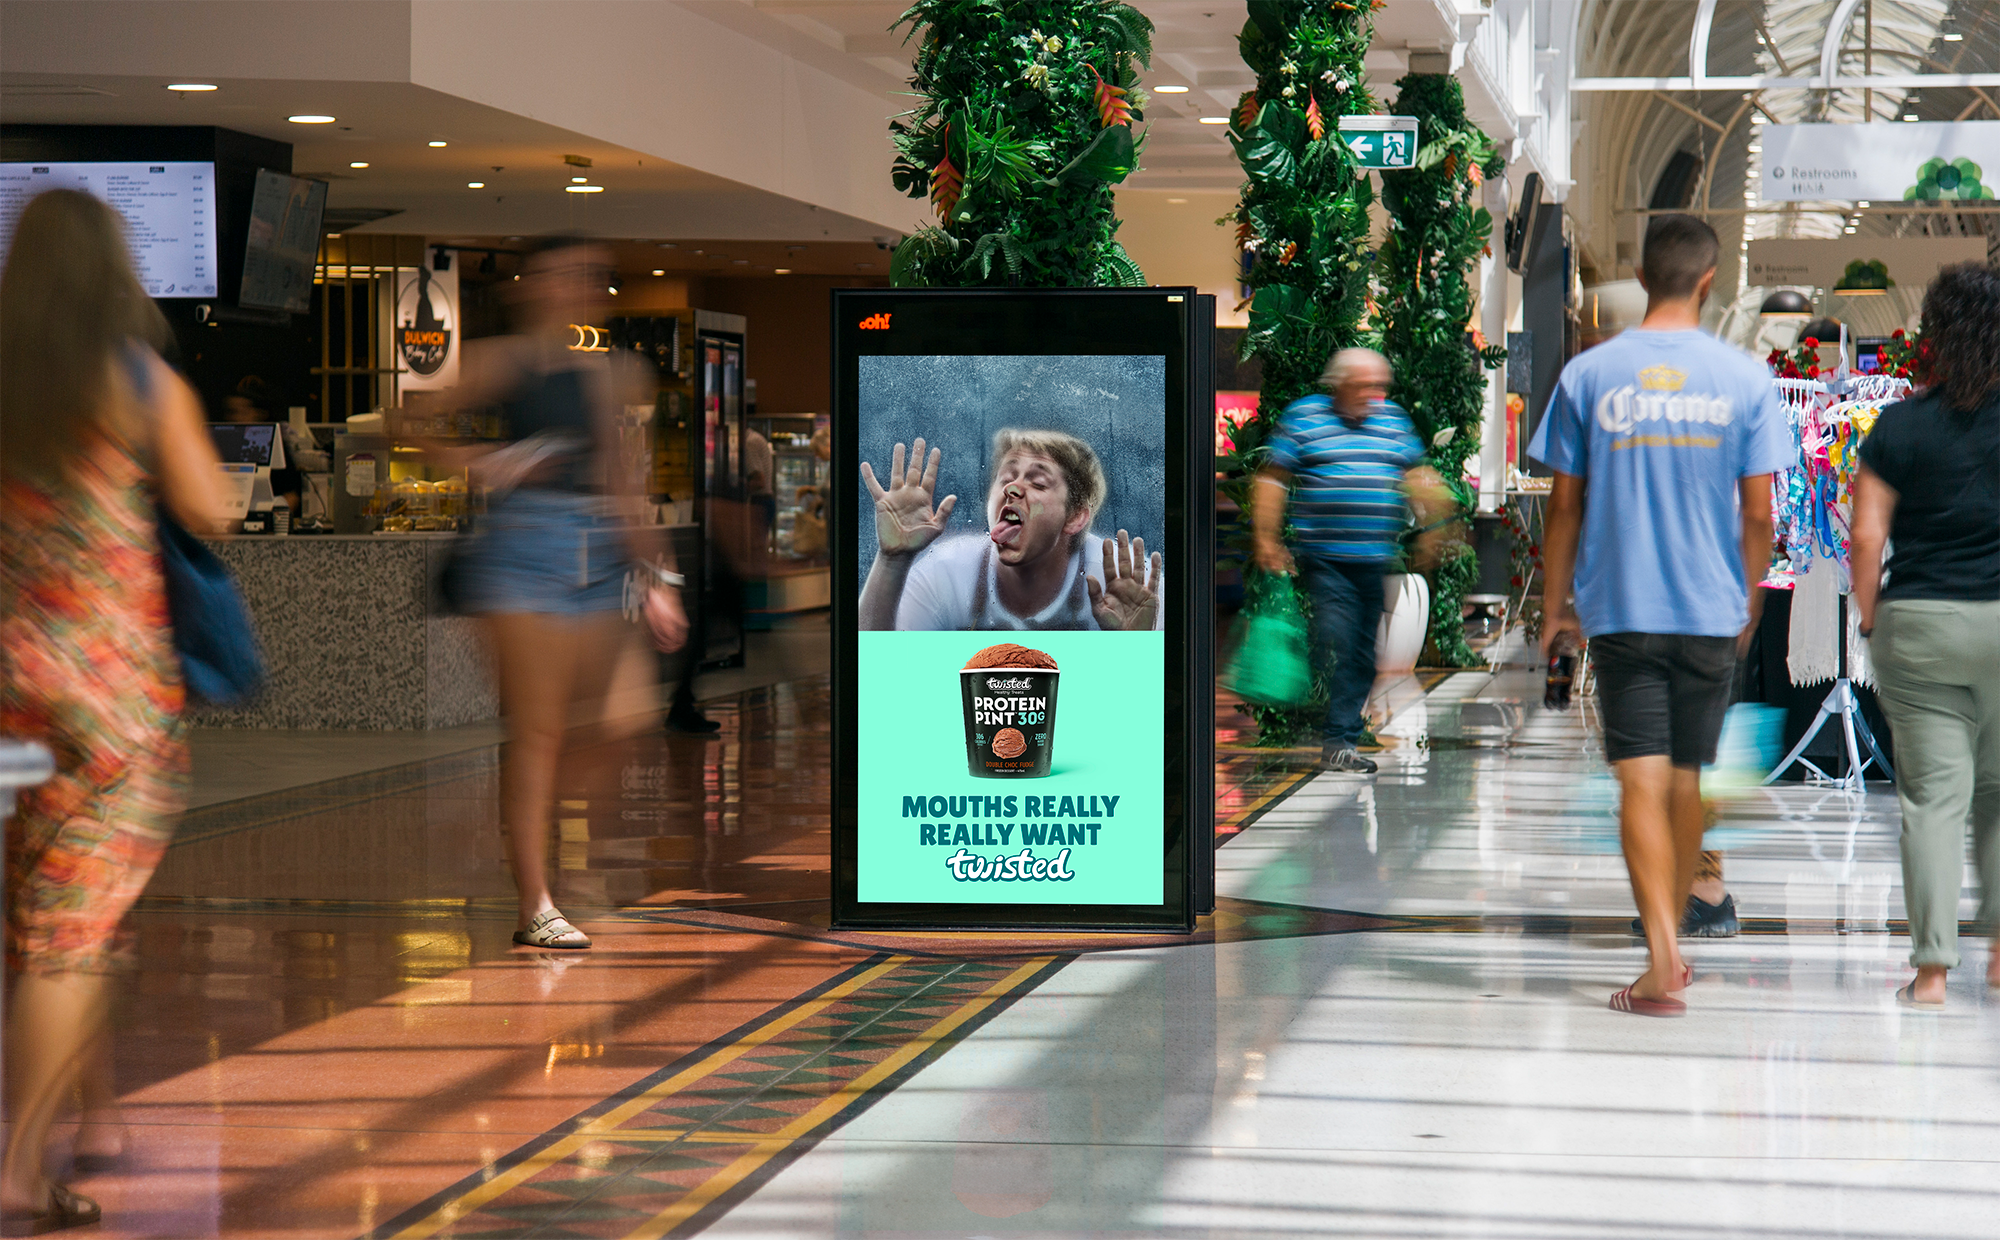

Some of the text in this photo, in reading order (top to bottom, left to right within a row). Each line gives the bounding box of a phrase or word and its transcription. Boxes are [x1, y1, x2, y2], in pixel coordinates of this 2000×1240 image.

[1791, 166, 1857, 180] Restrooms
[1597, 384, 1735, 436] Corona
[986, 677, 1032, 690] twisted
[974, 696, 1046, 711] PROTEIN
[975, 711, 1015, 725] PINT
[902, 795, 1120, 818] MOUTHS REALLY
[920, 823, 1102, 846] REALLY WANT
[946, 847, 1075, 882] twisted
